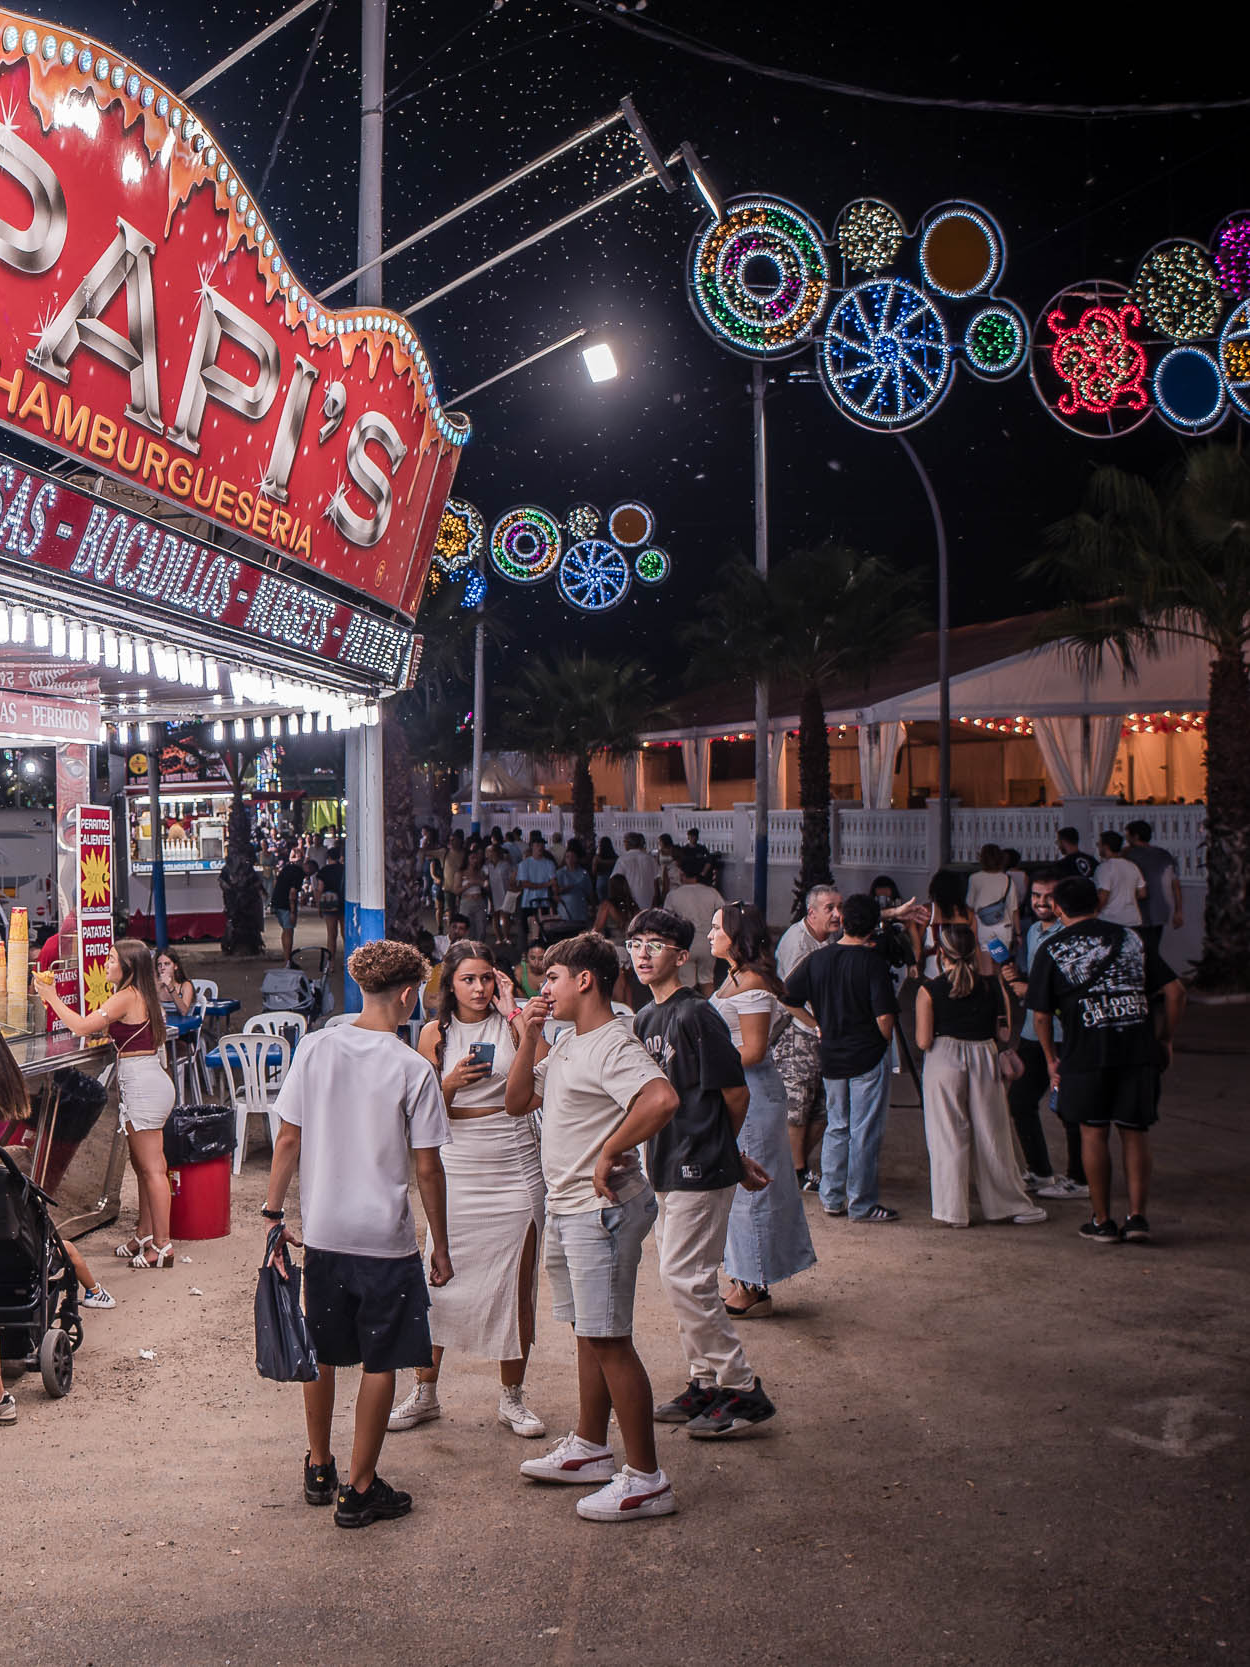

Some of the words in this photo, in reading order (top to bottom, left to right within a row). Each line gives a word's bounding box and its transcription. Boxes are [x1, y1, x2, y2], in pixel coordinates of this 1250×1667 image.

[73, 503, 241, 618] BOCADILLOS
[32, 704, 89, 732] PERRITOS
[80, 818, 109, 830] PERRITOS
[82, 926, 110, 938] PATATAS
[86, 943, 109, 956] FRITAS
